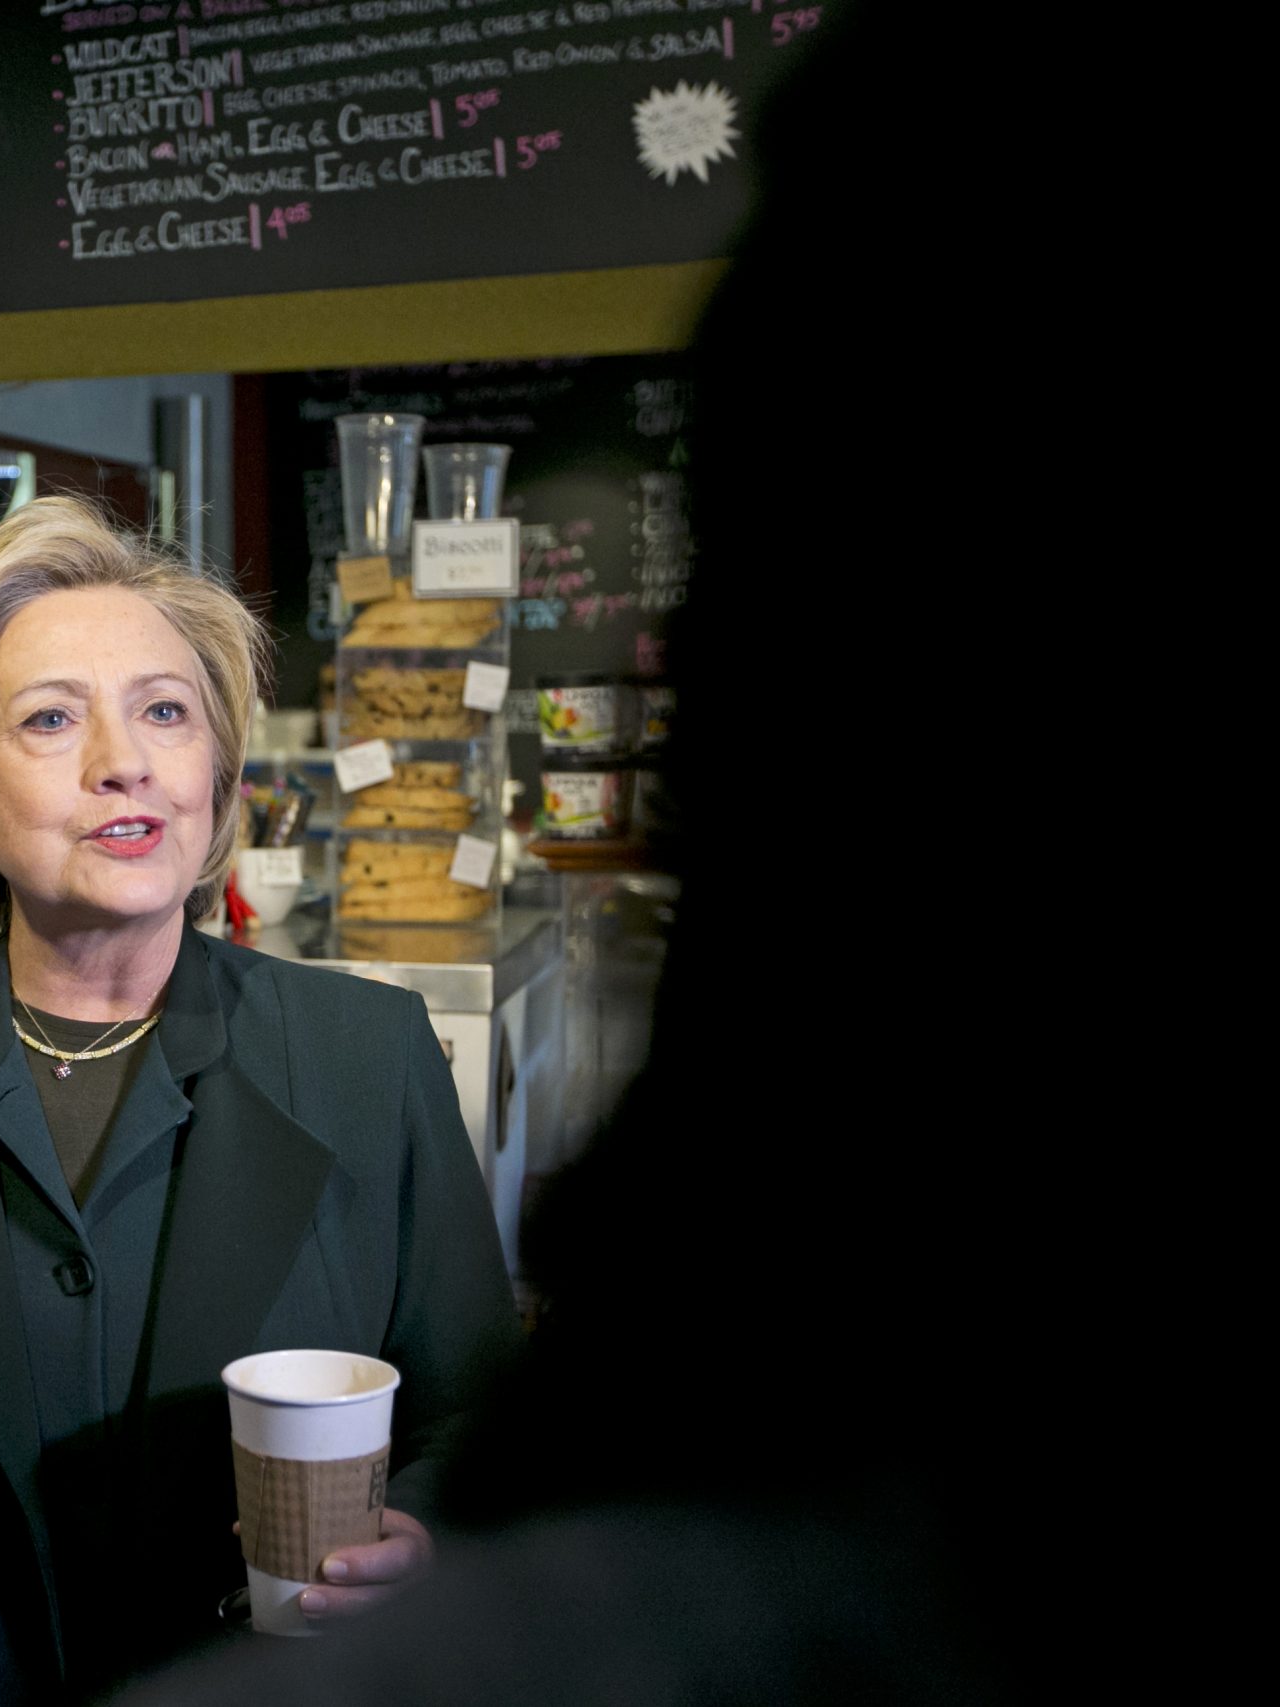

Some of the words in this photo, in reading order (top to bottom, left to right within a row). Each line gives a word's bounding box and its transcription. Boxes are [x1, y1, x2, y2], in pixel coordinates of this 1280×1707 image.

[62, 30, 176, 71] WILDCAT
[66, 51, 231, 107] JEFFERSON
[68, 96, 202, 141] BURRITO
[647, 25, 722, 62] SALSA
[66, 139, 151, 178] BACON
[337, 103, 431, 145] CHEESE
[67, 174, 204, 216] VEGETARIAN
[399, 147, 494, 185] CHEESE
[71, 219, 137, 259] EGG
[135, 225, 158, 253] &
[157, 210, 250, 251] CHEESE
